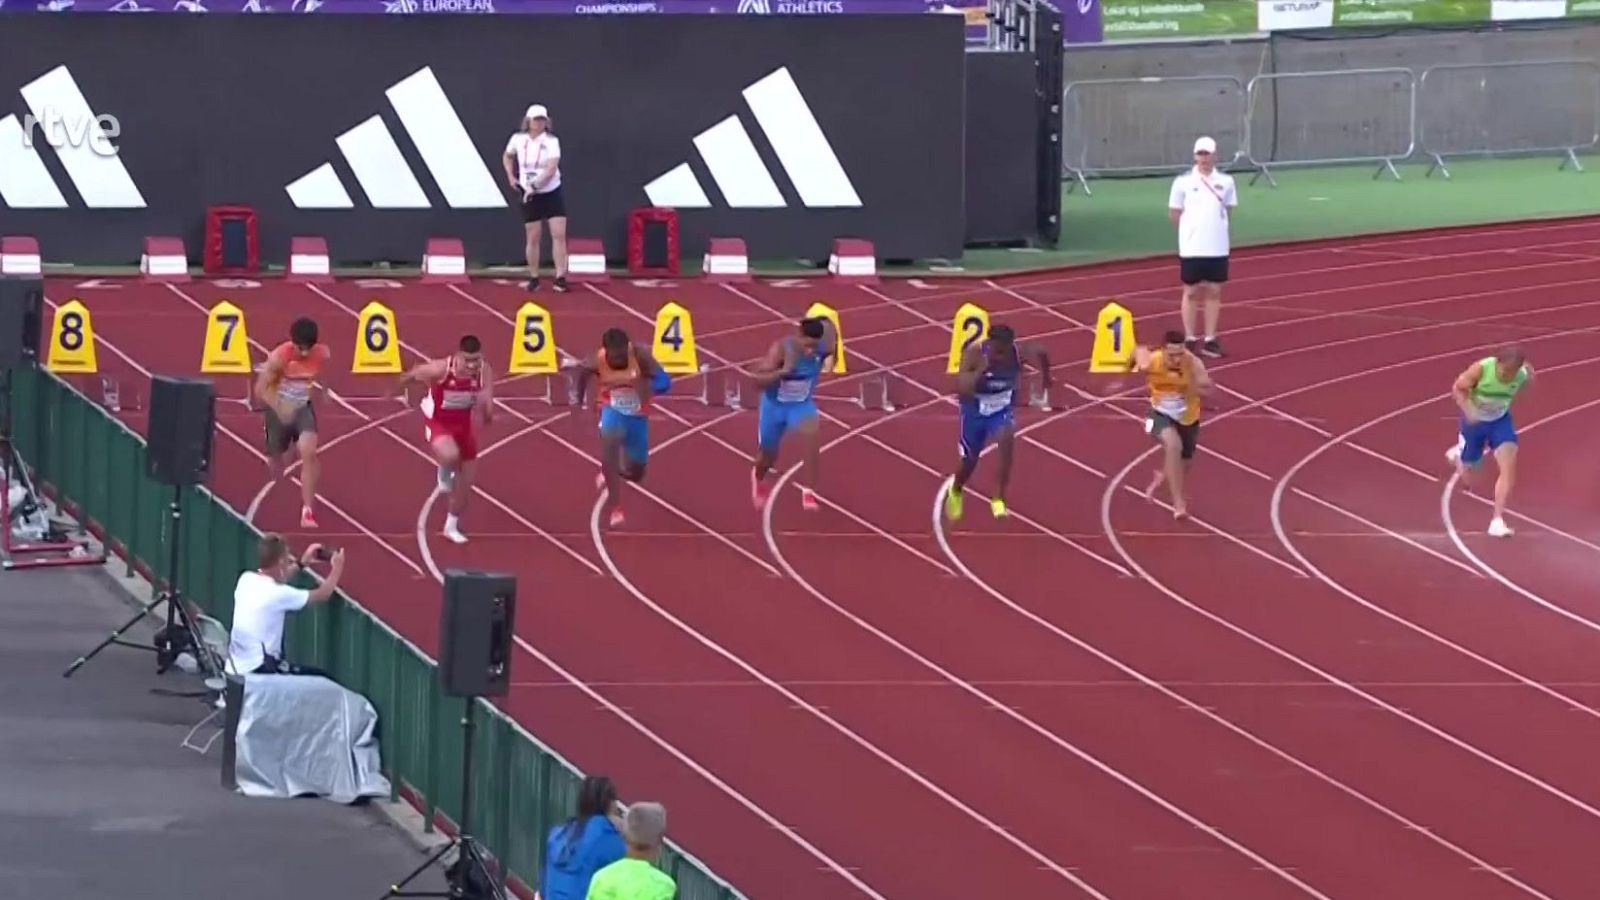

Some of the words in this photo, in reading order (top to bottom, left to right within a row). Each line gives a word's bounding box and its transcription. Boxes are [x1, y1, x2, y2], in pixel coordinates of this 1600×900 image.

[777, 1, 843, 13] ATHLETICS
[60, 312, 83, 351] 8
[216, 314, 239, 352] 7
[365, 314, 389, 352] 6
[523, 315, 545, 353] 5
[661, 316, 683, 352] 4
[962, 317, 983, 351] 2
[1106, 316, 1122, 352] 1
